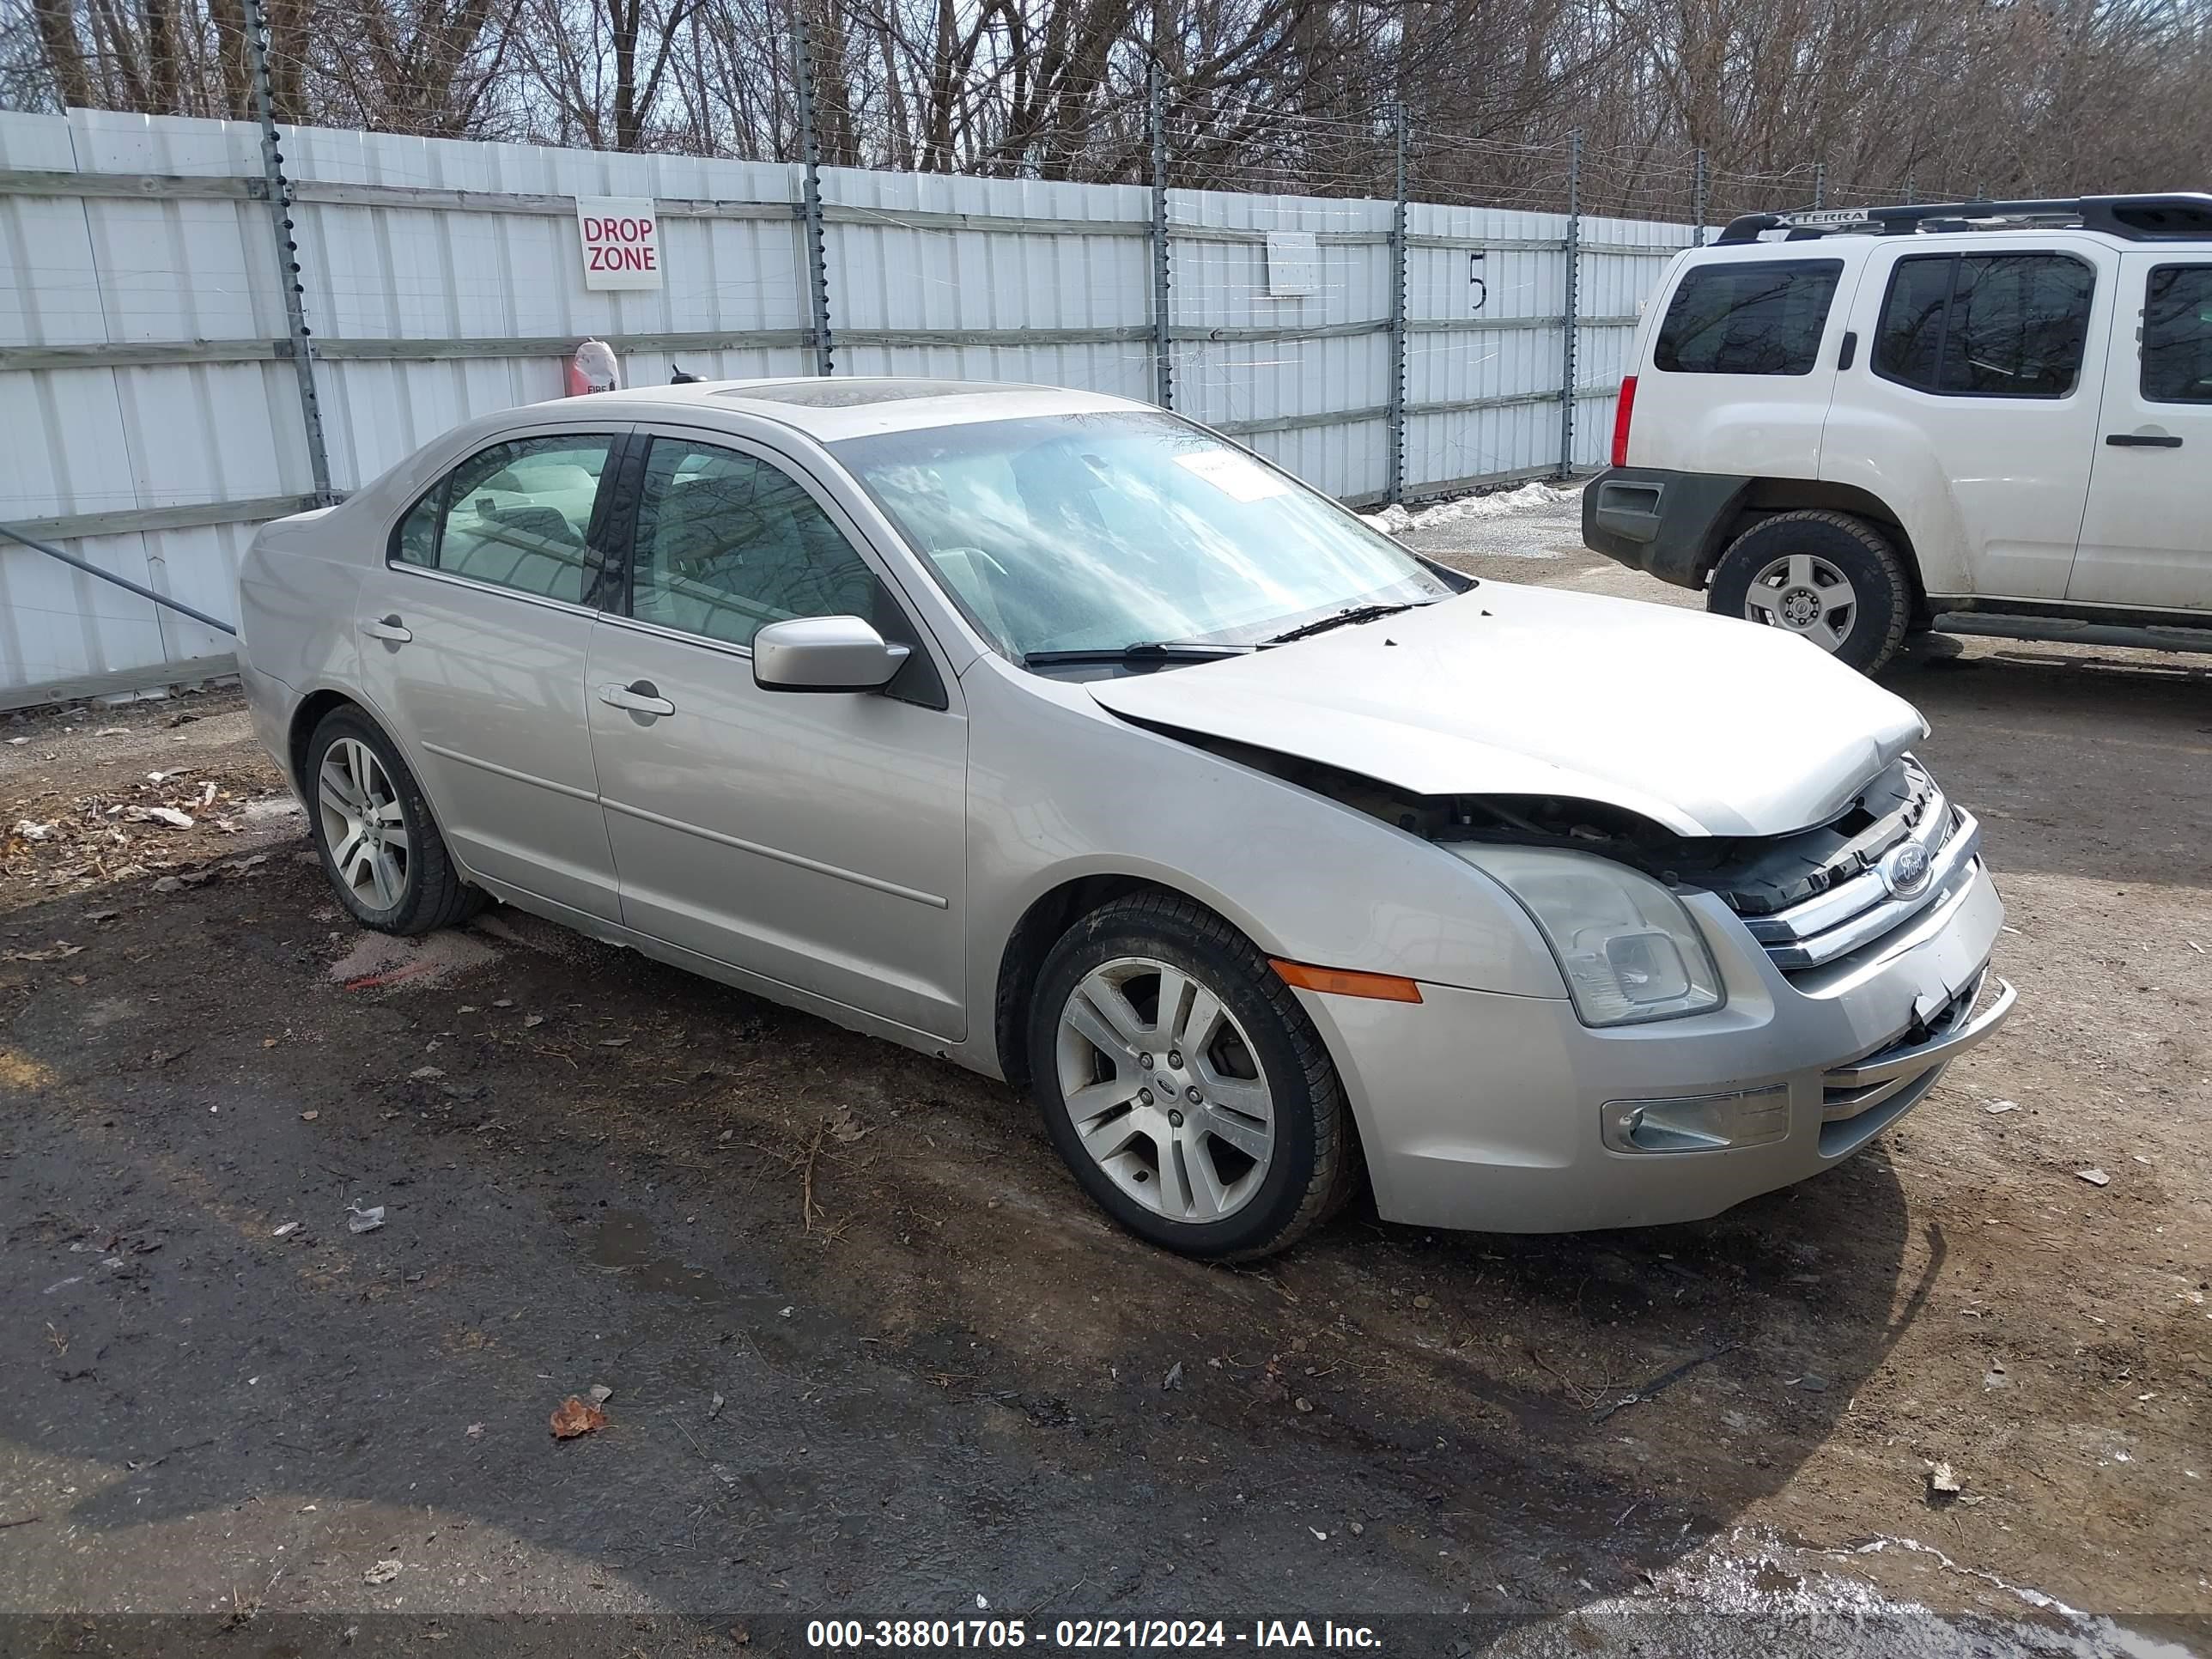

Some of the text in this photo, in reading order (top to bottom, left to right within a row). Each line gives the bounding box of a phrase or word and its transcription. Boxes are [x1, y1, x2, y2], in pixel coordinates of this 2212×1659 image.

[584, 217, 653, 242] DROP
[1773, 212, 1865, 227] XTERRA
[588, 246, 657, 270] ZONE
[1470, 252, 1487, 310] 5
[587, 386, 606, 394] FIRE
[1900, 851, 1924, 880] Ford
